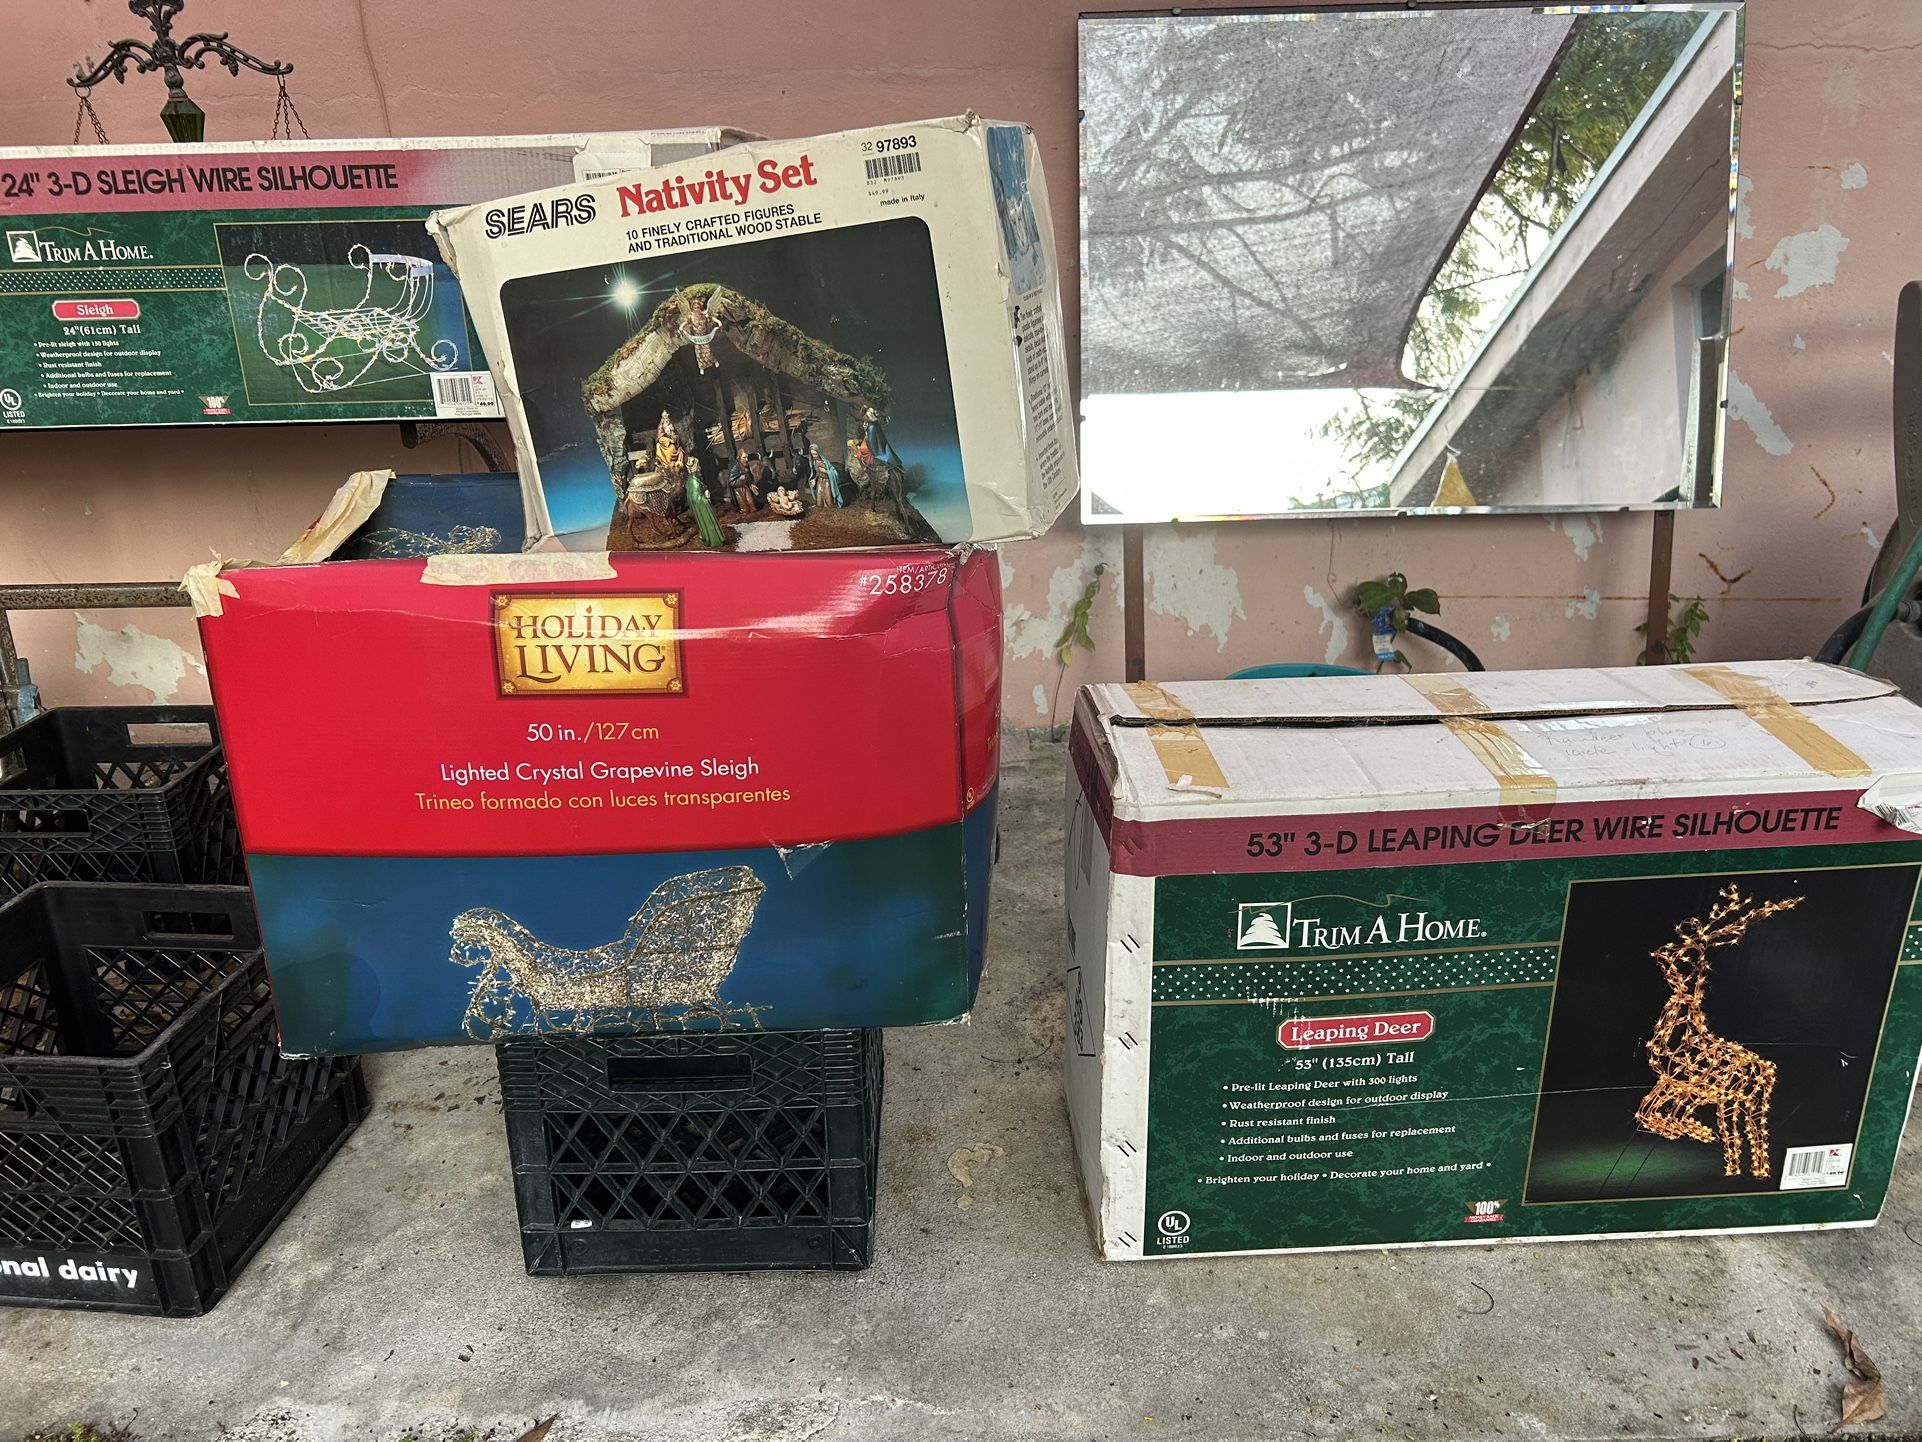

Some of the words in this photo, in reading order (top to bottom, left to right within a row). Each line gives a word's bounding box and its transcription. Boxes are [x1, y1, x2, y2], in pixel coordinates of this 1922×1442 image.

[861, 142, 872, 151] 32
[876, 136, 916, 152] 97893
[2, 172, 40, 197] 24"
[47, 171, 92, 196] 3-D
[97, 169, 186, 194] SLEIGH
[187, 167, 252, 192] WIRE
[257, 164, 399, 191] SILHOUETTE
[616, 168, 752, 218] Nativity
[757, 154, 817, 193] Set
[880, 198, 899, 206] made
[485, 194, 597, 239] SEARS
[626, 230, 638, 240] 10
[642, 222, 681, 238] FINELY
[685, 213, 740, 232] CRAFTED
[745, 204, 794, 222] FIGURES
[628, 241, 652, 253] AND
[654, 229, 733, 249] TRADITIONAL
[735, 222, 772, 236] WOOD
[776, 212, 822, 230] STABLE
[84, 241, 100, 260] A
[77, 305, 114, 317] Sleigh
[119, 325, 141, 334] Tall
[860, 568, 947, 595] #258378
[508, 608, 663, 639] HOLIDAY
[514, 644, 666, 683] LIVING
[527, 724, 553, 742] 50
[441, 762, 509, 786] Lighted
[516, 761, 584, 785] Crystal
[591, 761, 694, 783] Grapevine
[700, 756, 759, 780] Sleigh
[415, 793, 474, 810] Trineo
[480, 791, 562, 809] formado
[569, 796, 603, 808] con
[610, 790, 657, 807] luces
[664, 788, 790, 809] transparentes
[1246, 832, 1296, 857] 53"
[1304, 830, 1358, 856] 3-D
[1368, 823, 1500, 853] LEAPING
[1593, 814, 1665, 841] WIRE
[1672, 807, 1842, 839] SILHOUETTE
[1365, 914, 1388, 944] A
[1291, 1024, 1369, 1041] Leaping
[1374, 1021, 1421, 1036] Deer
[1295, 1058, 1318, 1070] 53"
[1322, 1054, 1381, 1070] (135cm)
[1387, 1051, 1414, 1064] Tall
[1231, 1083, 1265, 1092] Pre-lit
[1268, 1082, 1311, 1091] Leaping
[1314, 1080, 1340, 1088] Deer
[1343, 1078, 1366, 1087] with
[1368, 1077, 1386, 1085] 300
[1388, 1075, 1417, 1084] lights
[1229, 1100, 1306, 1110] Weatherproof
[1308, 1098, 1342, 1107] design
[1346, 1097, 1362, 1105] for
[1365, 1094, 1408, 1103] outdoor
[1410, 1091, 1448, 1101] display
[1229, 1120, 1254, 1128] Rust
[1257, 1117, 1303, 1126] resistant
[1306, 1116, 1336, 1124] finish
[1228, 1136, 1284, 1145] Additional
[1287, 1134, 1316, 1143] bulbs
[1319, 1133, 1338, 1141] and
[1342, 1132, 1368, 1140] fuses
[1371, 1130, 1387, 1138] for
[1390, 1125, 1456, 1137] replacement
[1227, 1154, 1264, 1162] Indoor
[1266, 1153, 1286, 1161] and
[1289, 1151, 1332, 1160] outdoor
[1205, 1176, 1250, 1185] Brighten
[1253, 1175, 1278, 1183] your
[1280, 1173, 1319, 1182] holiday
[1330, 1171, 1377, 1179] Decorate
[1380, 1168, 1404, 1178] your
[1438, 1164, 1457, 1172] and
[1459, 1162, 1484, 1171] yard
[1166, 1216, 1182, 1230] UL
[1157, 1236, 1190, 1245] LISTED
[58, 1259, 138, 1288] dairy
